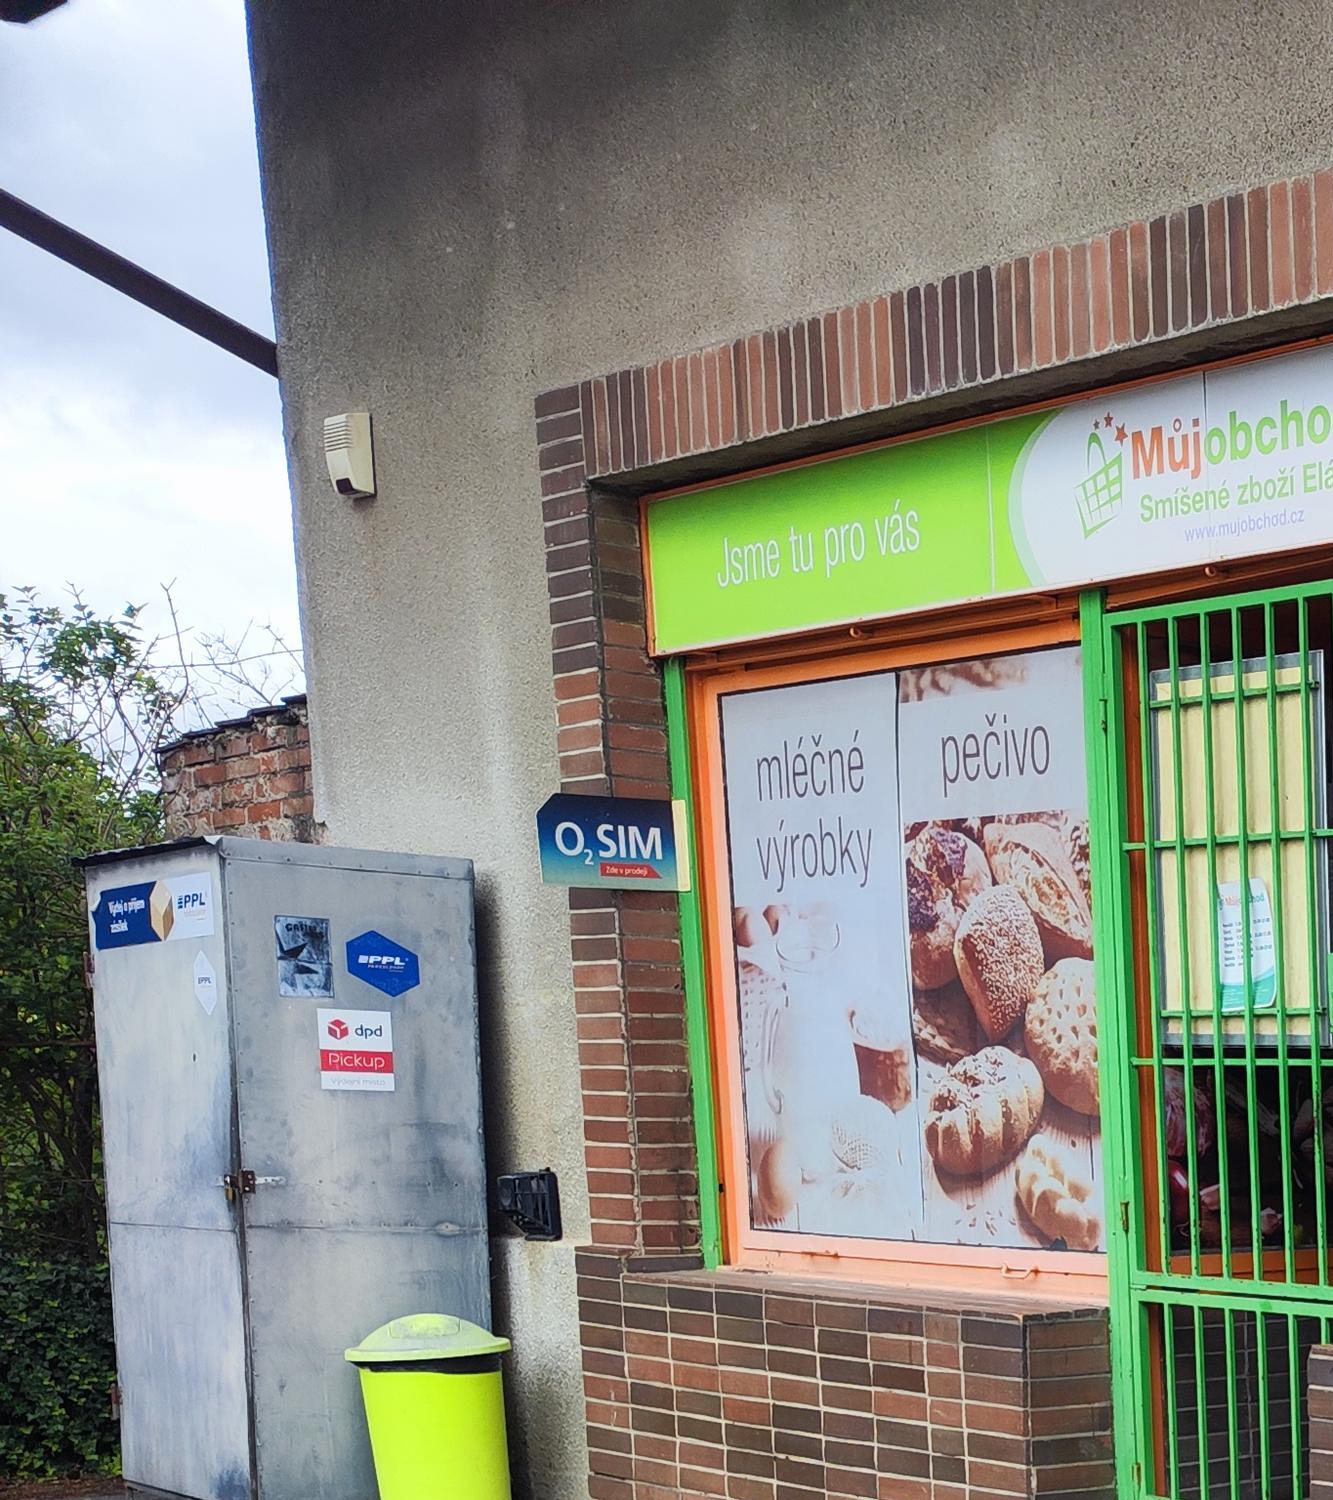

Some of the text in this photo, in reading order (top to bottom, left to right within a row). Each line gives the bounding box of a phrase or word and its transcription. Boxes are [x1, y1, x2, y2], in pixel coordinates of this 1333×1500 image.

[1140, 479, 1230, 523] Smíšené
[1237, 466, 1296, 506] zboží
[717, 499, 920, 588] Jsme tu pro vás
[1185, 508, 1304, 542] www.mujobchod.cz
[756, 729, 864, 801] mléčné
[941, 712, 1050, 798] pečivo
[555, 821, 663, 865] O2 SIM
[756, 816, 872, 893] výrobky
[605, 866, 619, 874] Zde
[184, 892, 206, 908] PPL
[368, 955, 406, 966] PPL
[354, 1024, 383, 1040] dpd
[328, 1052, 385, 1070] Pickup
